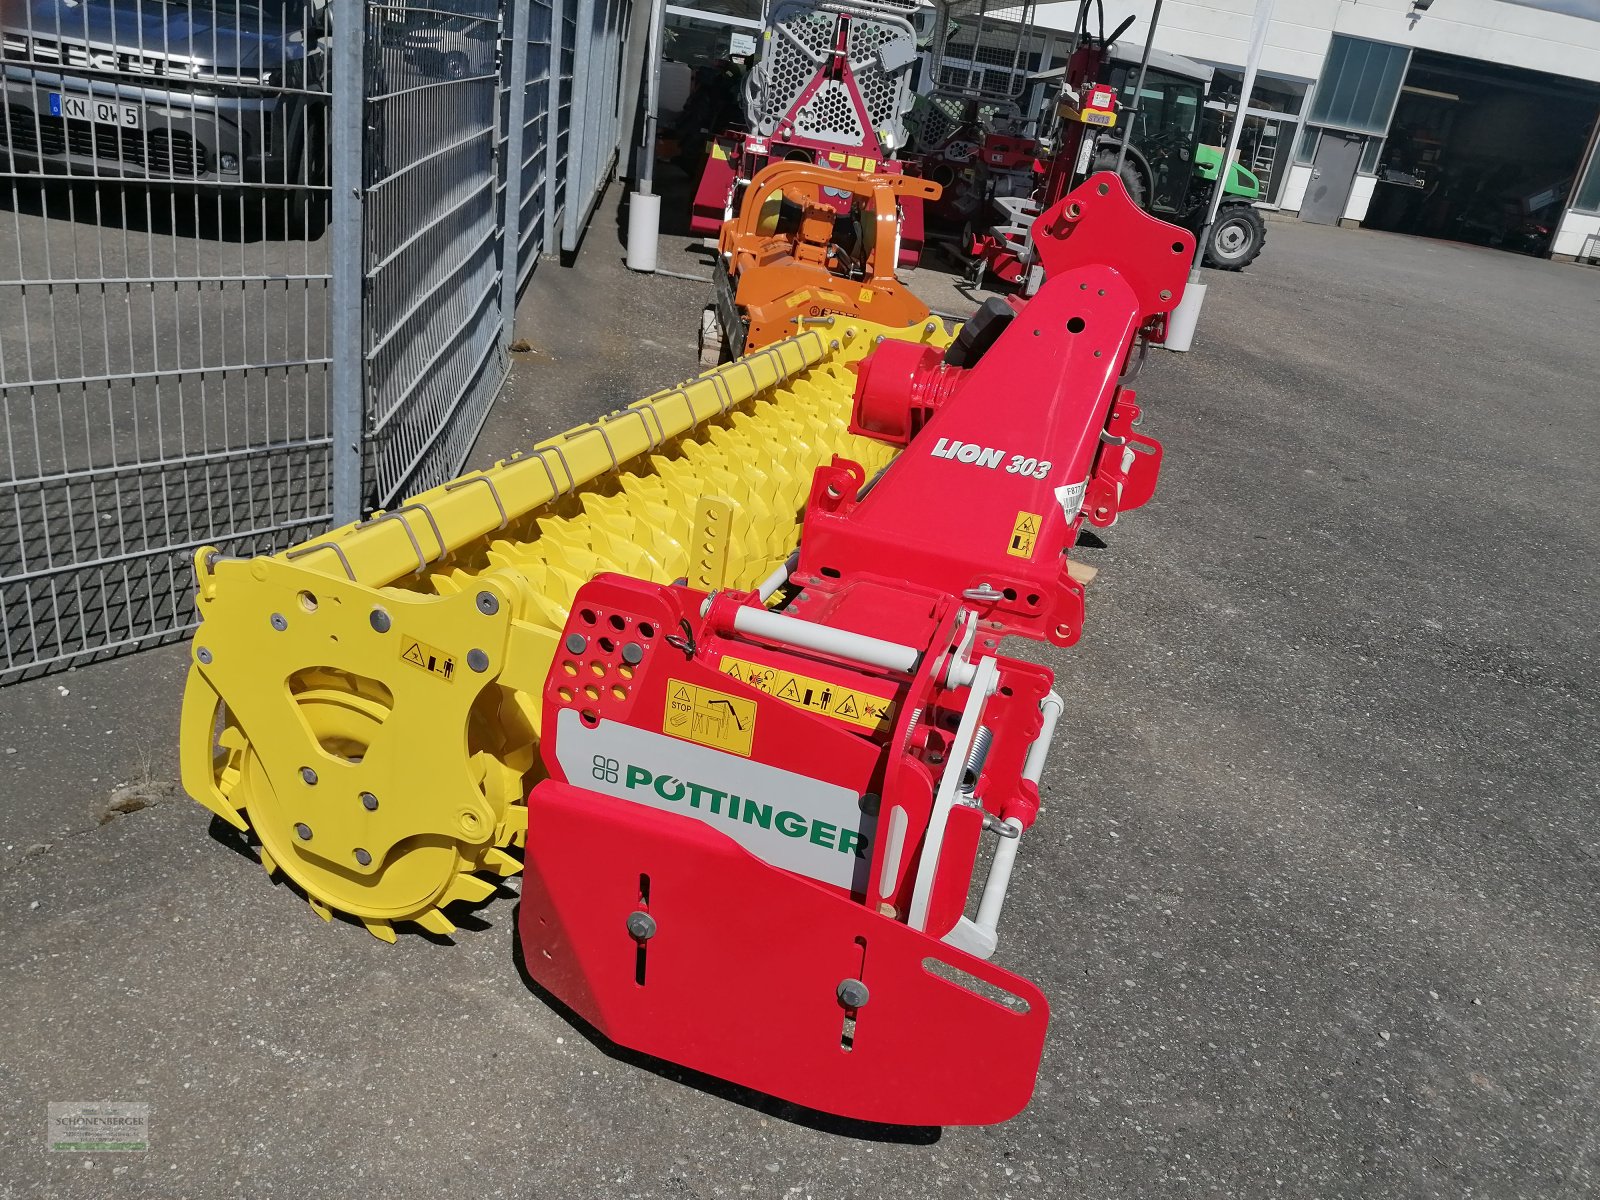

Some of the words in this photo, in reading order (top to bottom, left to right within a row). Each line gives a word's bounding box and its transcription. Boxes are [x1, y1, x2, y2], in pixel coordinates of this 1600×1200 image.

[126, 108, 136, 124] 5
[930, 437, 1006, 470] LION
[1005, 454, 1052, 480] 303
[672, 701, 692, 712] STOP
[625, 764, 869, 860] PÖTTINGER
